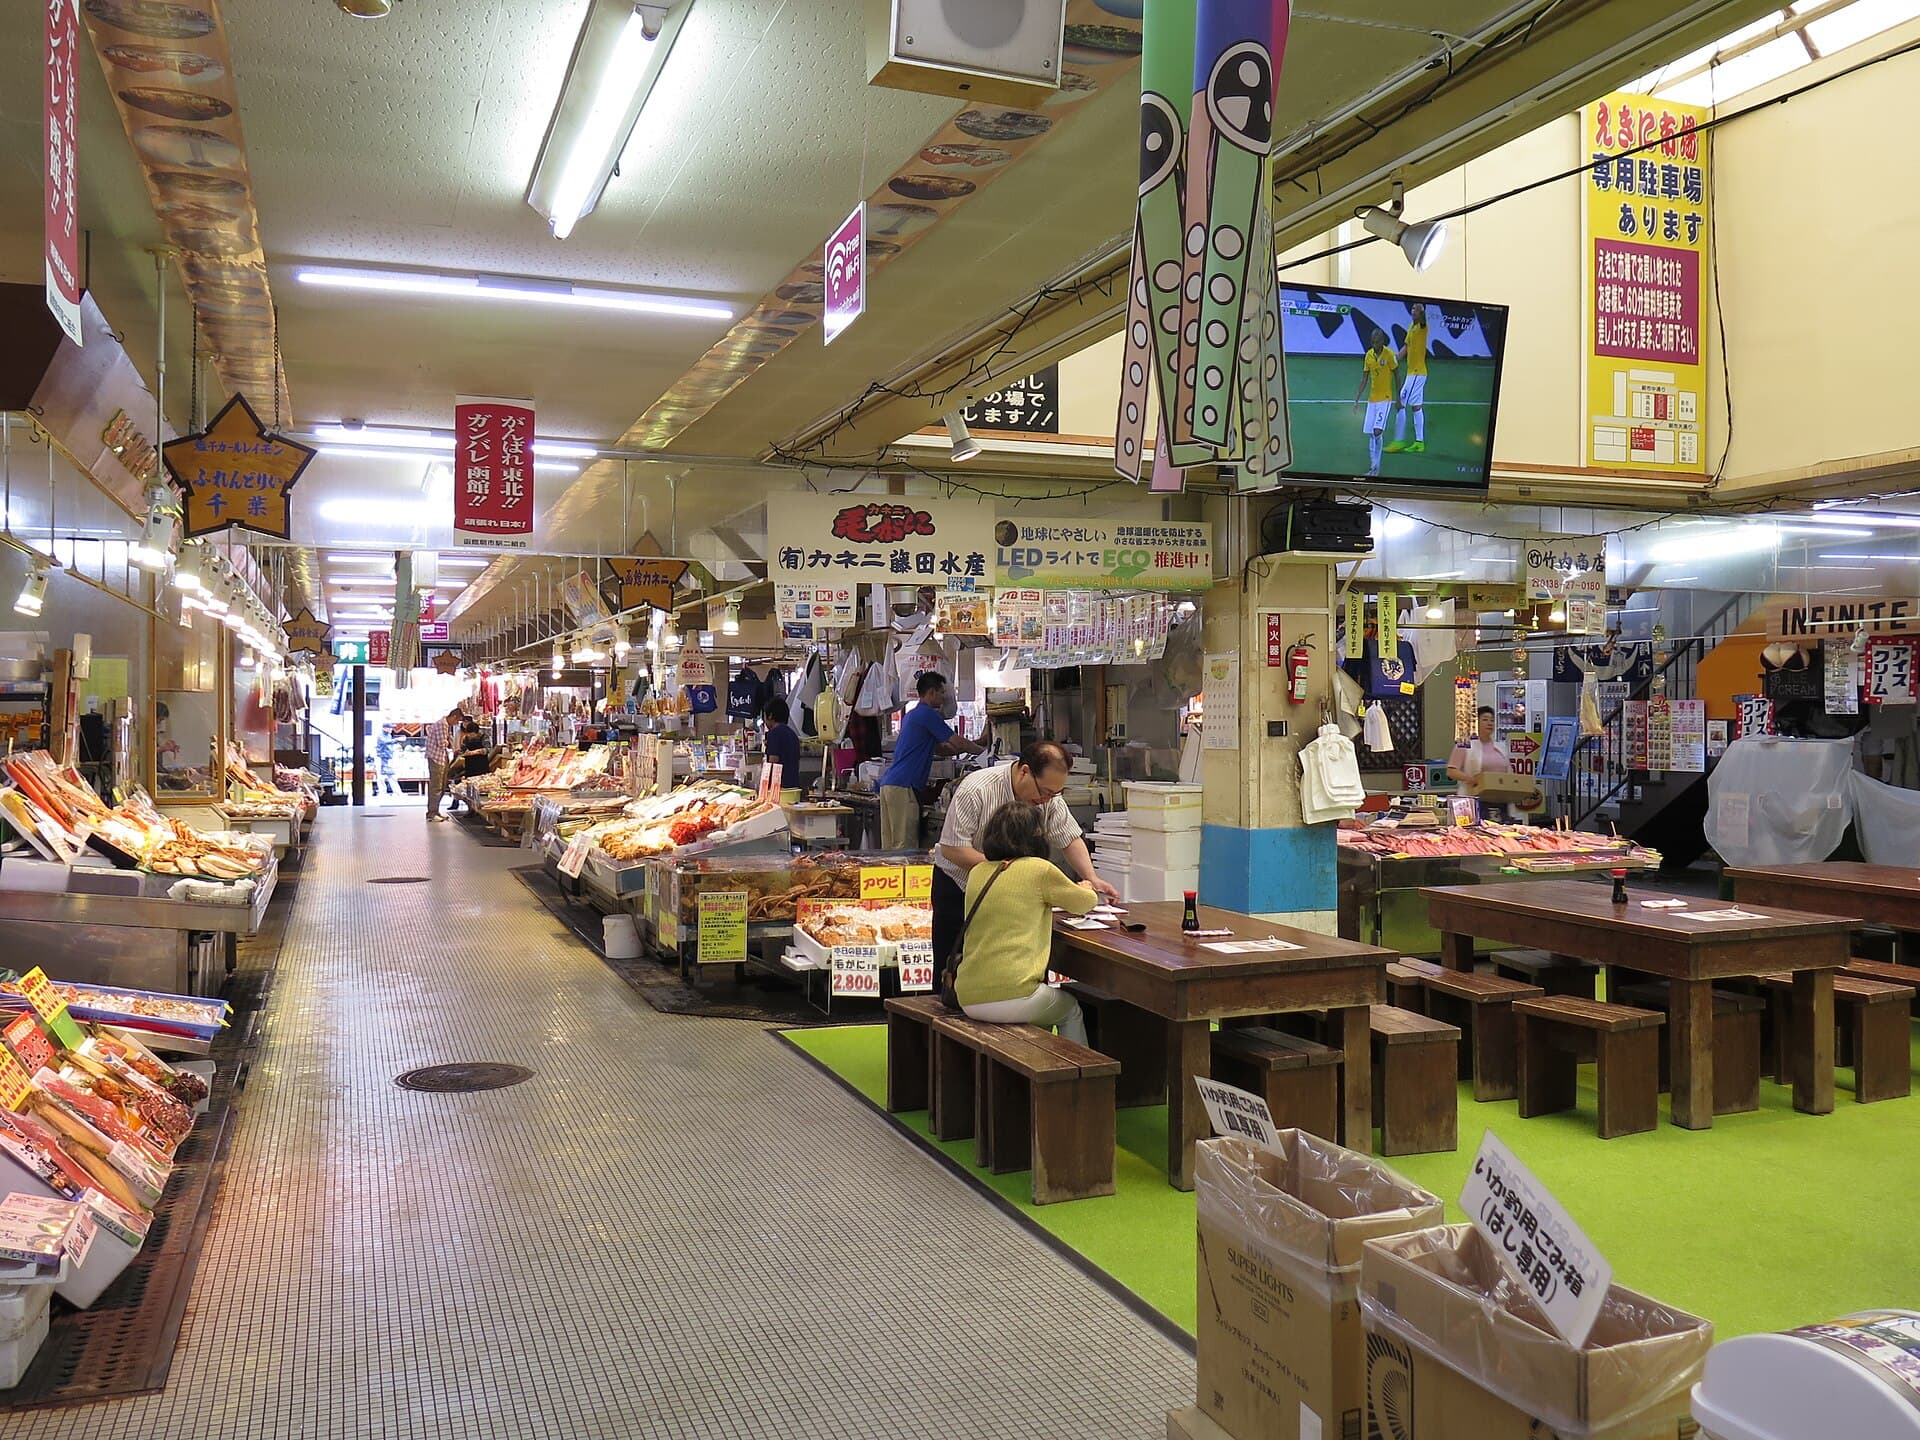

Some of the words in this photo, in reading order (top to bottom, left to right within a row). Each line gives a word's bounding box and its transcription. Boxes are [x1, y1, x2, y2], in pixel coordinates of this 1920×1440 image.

[1592, 153, 1703, 204] 専用駐車場
[1619, 203, 1703, 244] あります
[465, 413, 492, 507] ガンバレ函館!!
[500, 415, 526, 508] がんばれ東北!!
[206, 493, 268, 518] 千葉
[1021, 526, 1107, 542] 地球にやさしい
[997, 548, 1043, 567] LED
[1045, 551, 1100, 565] ライトで
[1103, 550, 1150, 568] ECO
[1268, 615, 1279, 655] 消火器
[1782, 601, 1909, 636] INFINITE
[1872, 650, 1889, 695] クリーム
[1892, 646, 1909, 688] アイス
[1755, 700, 1767, 734] アイス
[863, 875, 900, 890] アワビ
[834, 959, 866, 970] 毛がに
[902, 953, 932, 963] 毛がに
[1475, 1157, 1586, 1299] いか釣用ごみ箱
[1479, 1197, 1558, 1305] (はし専用)
[1227, 1247, 1257, 1277] SUPER
[1259, 1270, 1295, 1303] LIGHTS
